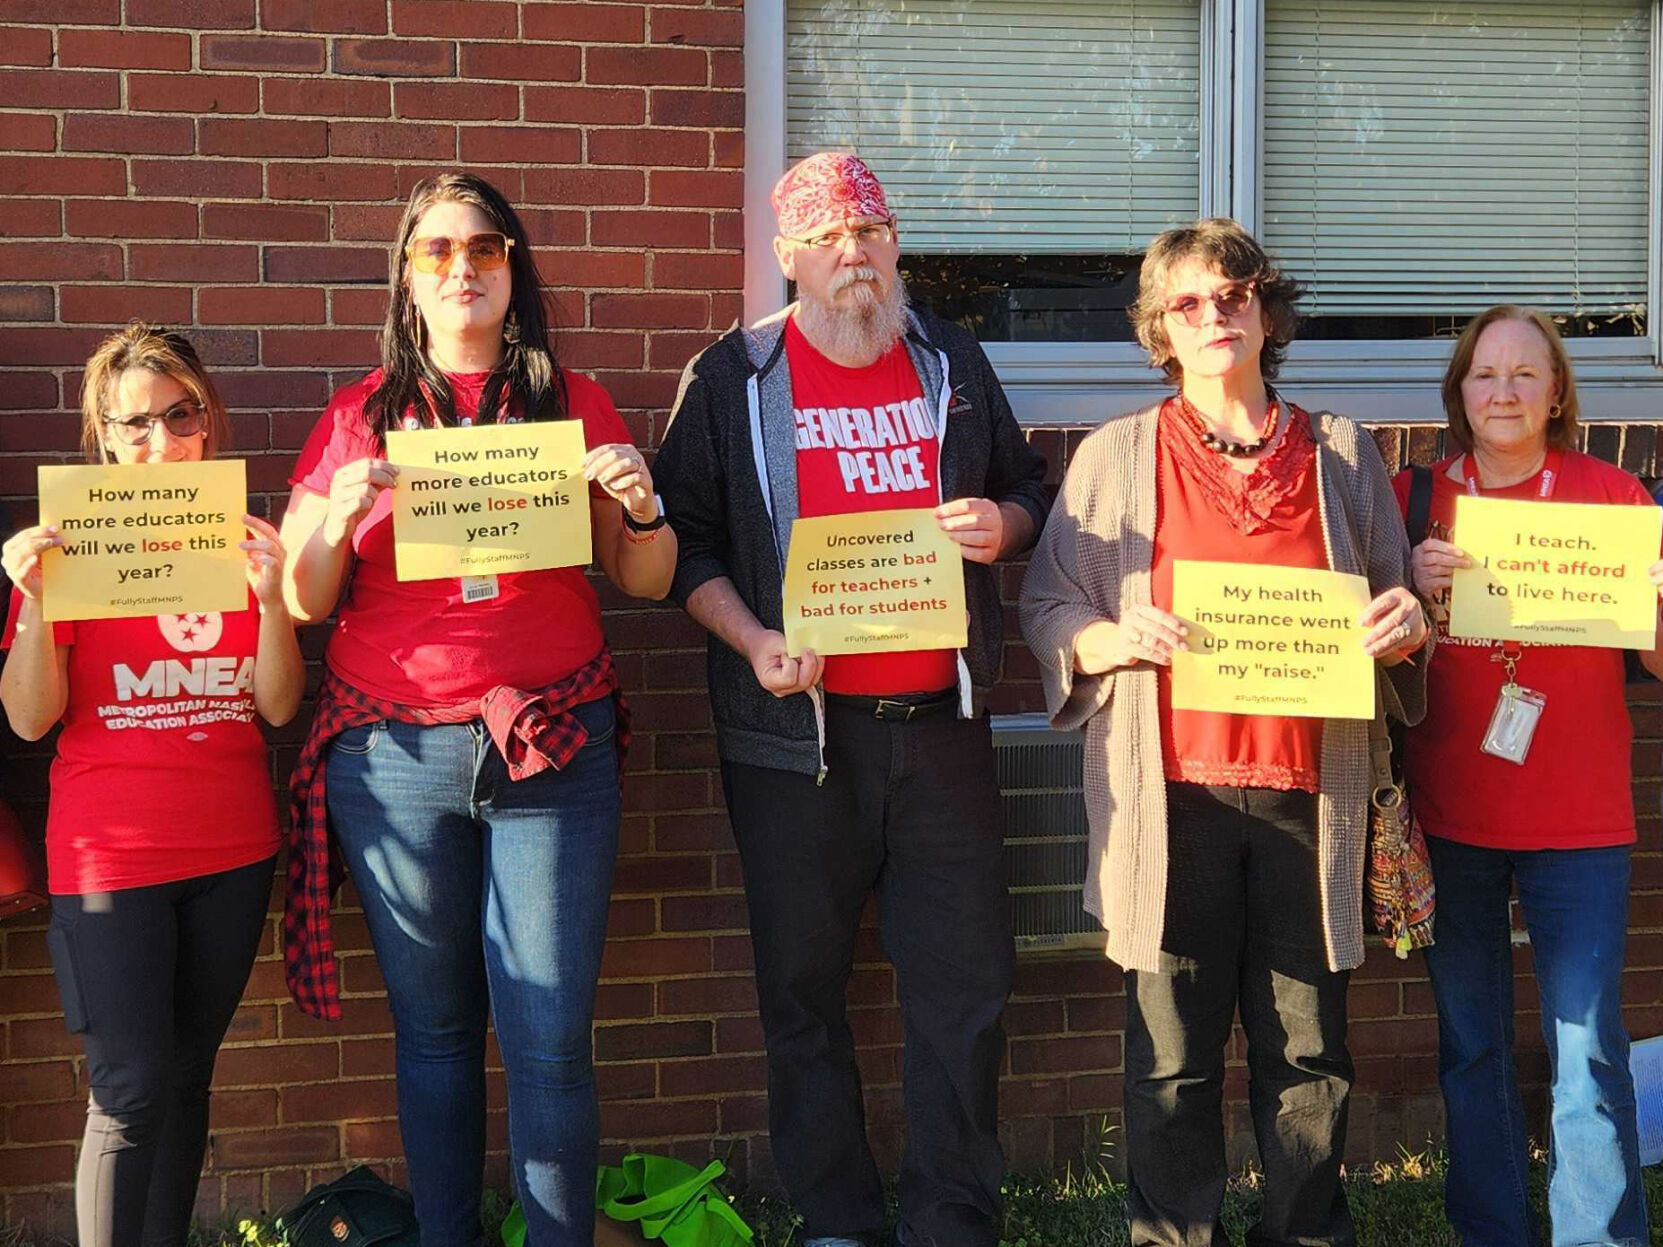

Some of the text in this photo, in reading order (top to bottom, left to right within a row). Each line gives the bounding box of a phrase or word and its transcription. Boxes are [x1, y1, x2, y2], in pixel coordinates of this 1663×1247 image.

[434, 446, 540, 464] How many
[411, 467, 568, 491] more educators
[837, 446, 931, 493] PEACE
[89, 486, 199, 502] How many
[411, 491, 570, 517] will we lose this
[62, 512, 226, 529] more educators
[466, 521, 520, 542] year?
[827, 530, 914, 547] Uncovered
[1516, 533, 1596, 550] I teach.
[61, 534, 227, 556] will we lose this
[807, 551, 937, 571] classes are bad
[1484, 556, 1626, 578] I can't afford
[117, 563, 174, 584] year?
[811, 576, 932, 594] for teachers +
[1223, 585, 1323, 602] My health
[1486, 582, 1618, 604] to live here.
[110, 596, 183, 606] #FullyStaffMNPS
[801, 598, 947, 618] bad for students
[1195, 607, 1351, 629] insurance went
[1203, 636, 1340, 655] up more than
[112, 656, 255, 701] MNEA
[1218, 663, 1325, 680] my "raise."
